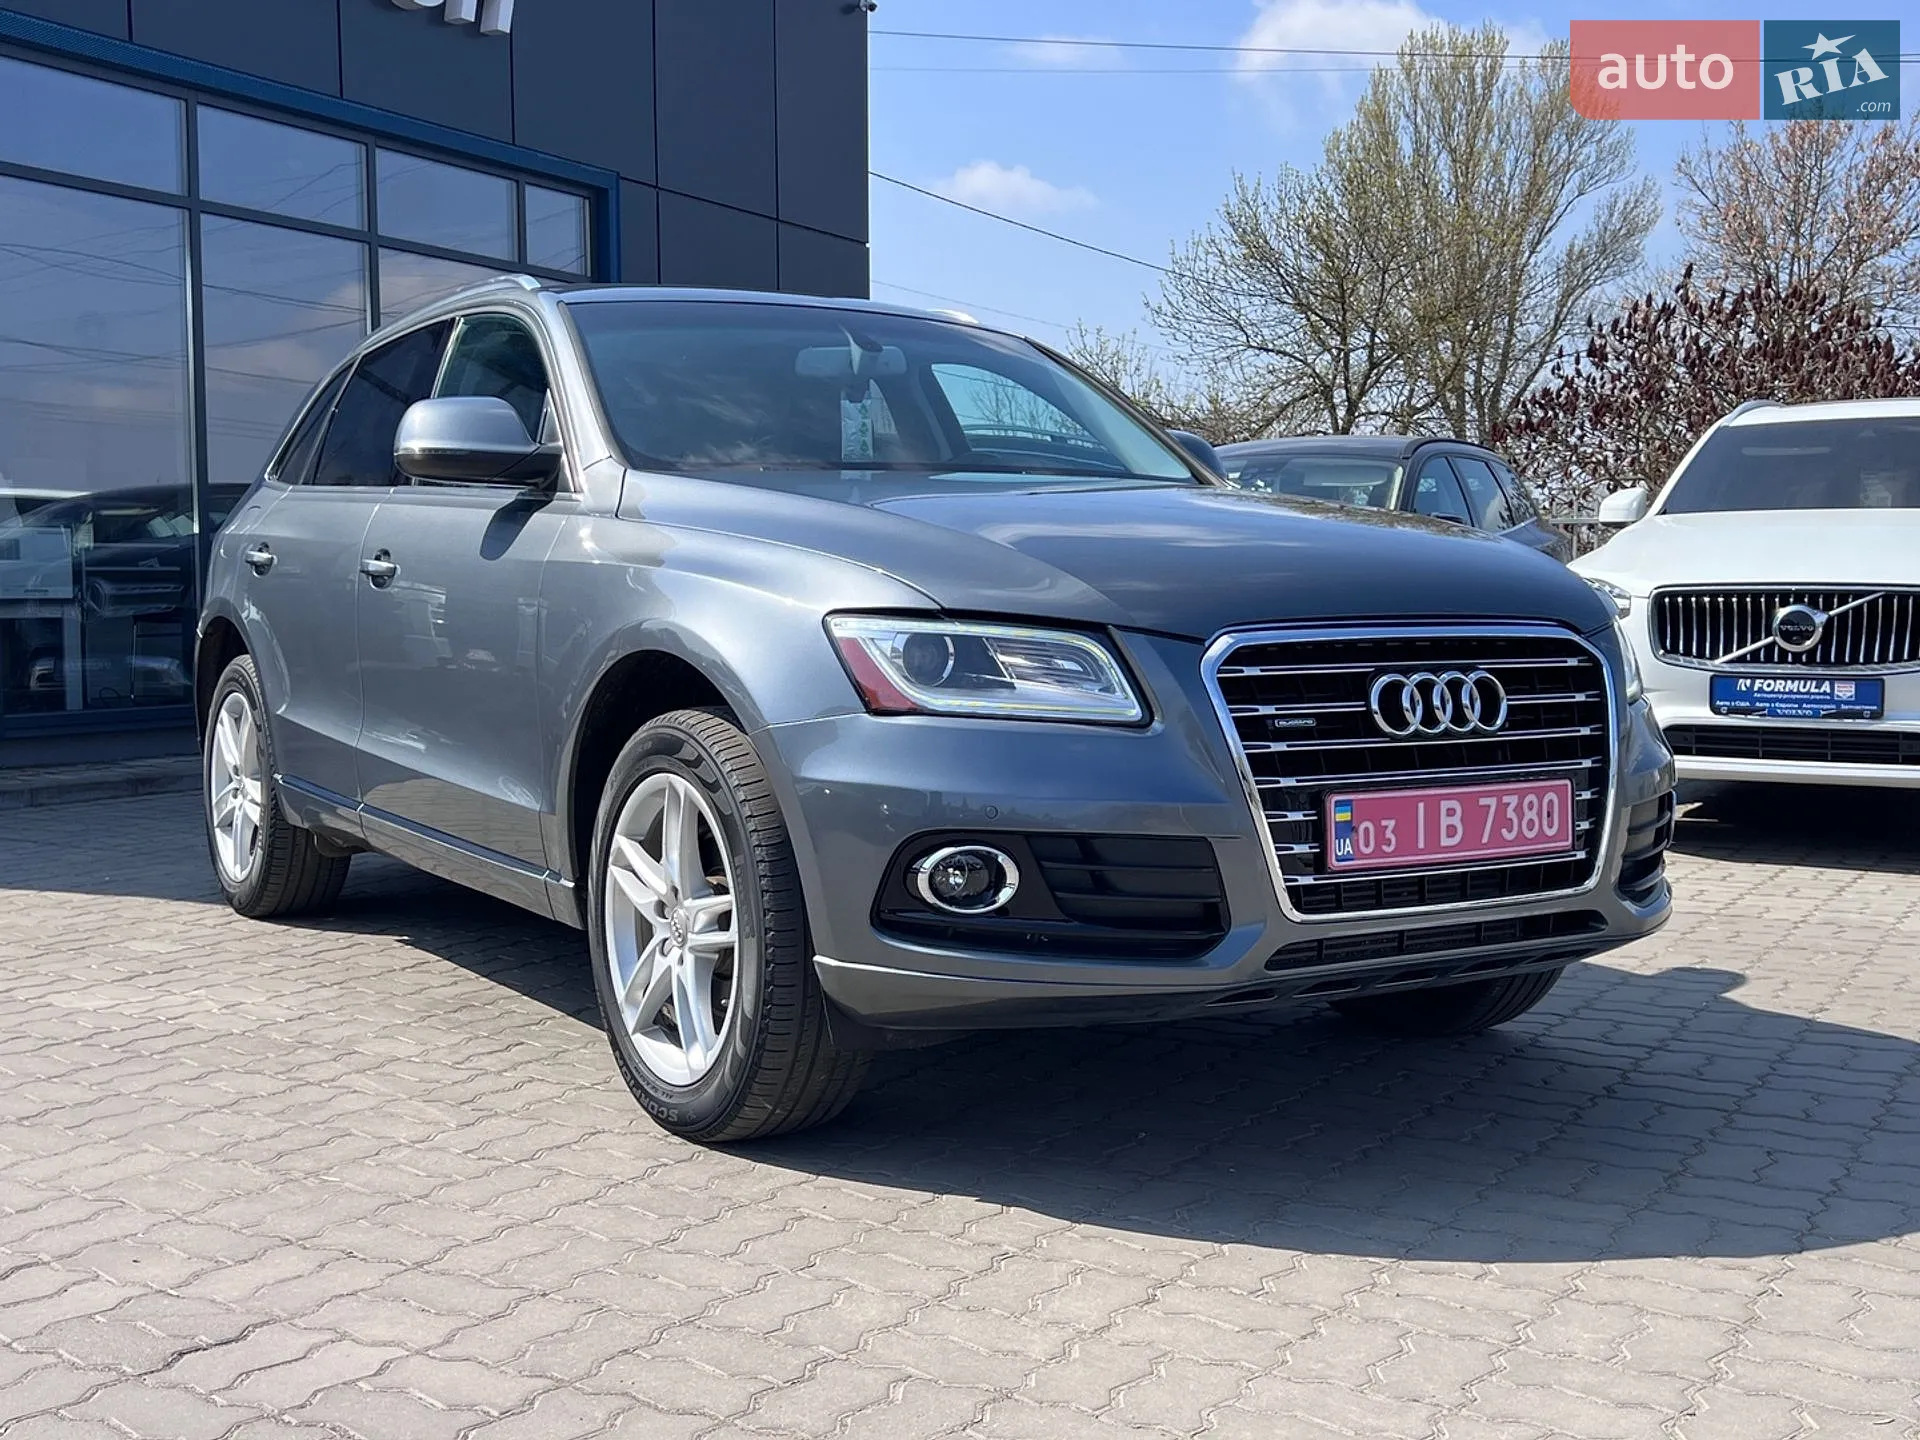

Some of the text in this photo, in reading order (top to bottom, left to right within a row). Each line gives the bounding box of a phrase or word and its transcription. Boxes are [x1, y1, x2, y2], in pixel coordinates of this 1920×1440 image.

[1753, 679, 1831, 693] FORMULA
[1358, 819, 1396, 854] 03
[1478, 791, 1559, 844] 7380
[1335, 838, 1352, 856] UA
